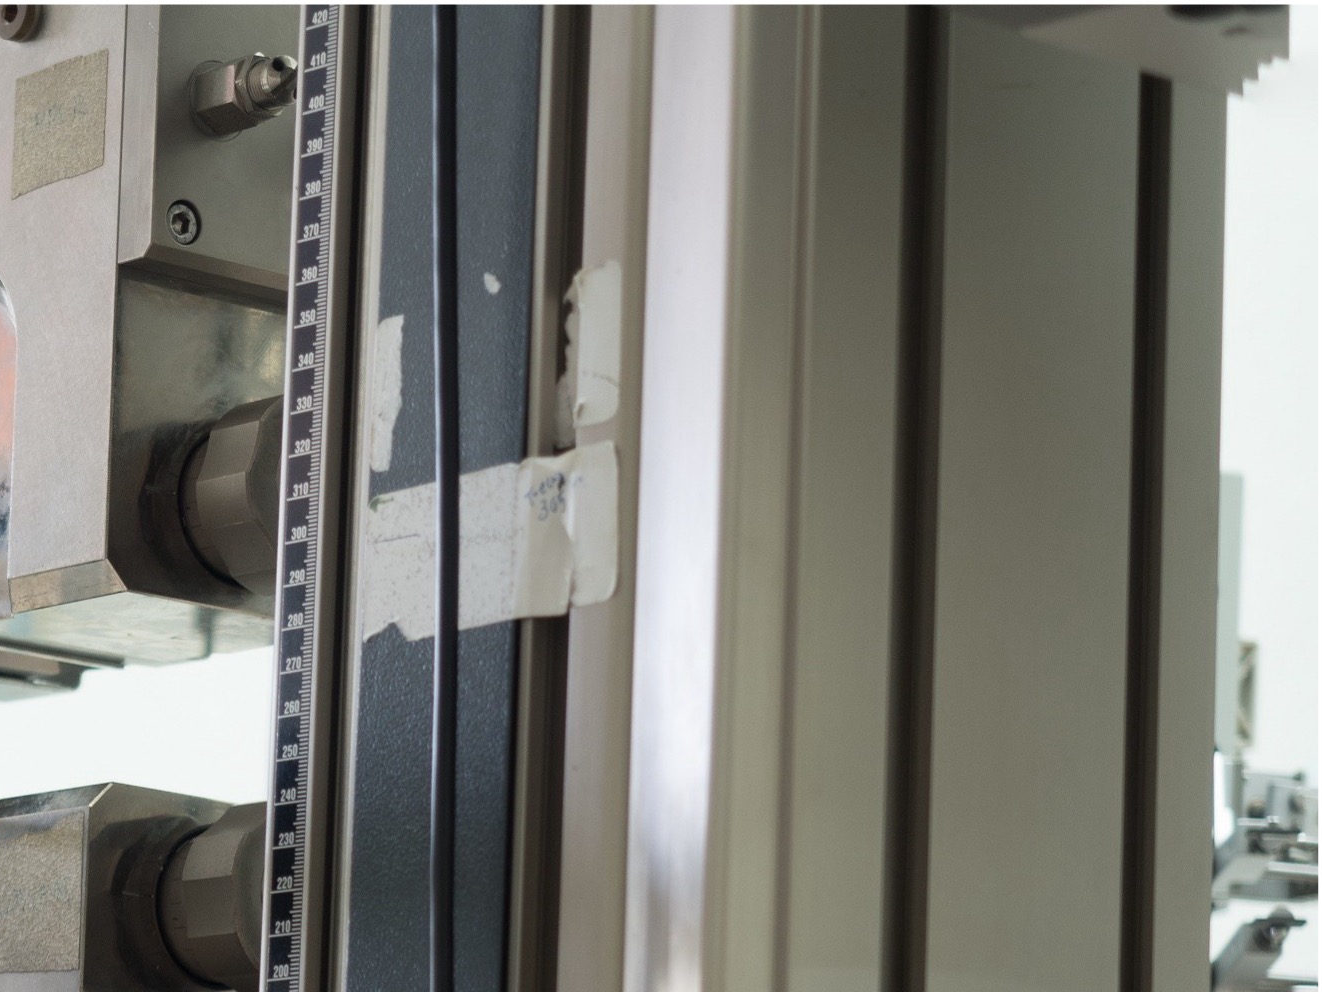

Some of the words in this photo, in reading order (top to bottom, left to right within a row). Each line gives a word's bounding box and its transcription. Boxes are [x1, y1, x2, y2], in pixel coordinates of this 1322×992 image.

[312, 11, 328, 24] 420
[310, 52, 326, 67] 410
[308, 94, 324, 108] 400
[307, 137, 322, 152] 390
[305, 180, 321, 195] 380
[303, 223, 319, 238] 370
[302, 266, 317, 281] 360
[300, 309, 316, 324] 350
[298, 352, 314, 367] 340
[296, 396, 312, 410] 330
[295, 439, 310, 453] 320
[293, 482, 308, 496] 310
[291, 526, 306, 540] 300
[290, 569, 305, 584] 290
[288, 613, 303, 627] 280
[286, 656, 301, 671] 270
[284, 700, 300, 714] 260
[283, 744, 298, 758] 250
[281, 788, 296, 802] 240
[279, 832, 294, 845] 230
[277, 876, 292, 890] 220
[275, 920, 290, 934] 210
[274, 965, 289, 978] 200
